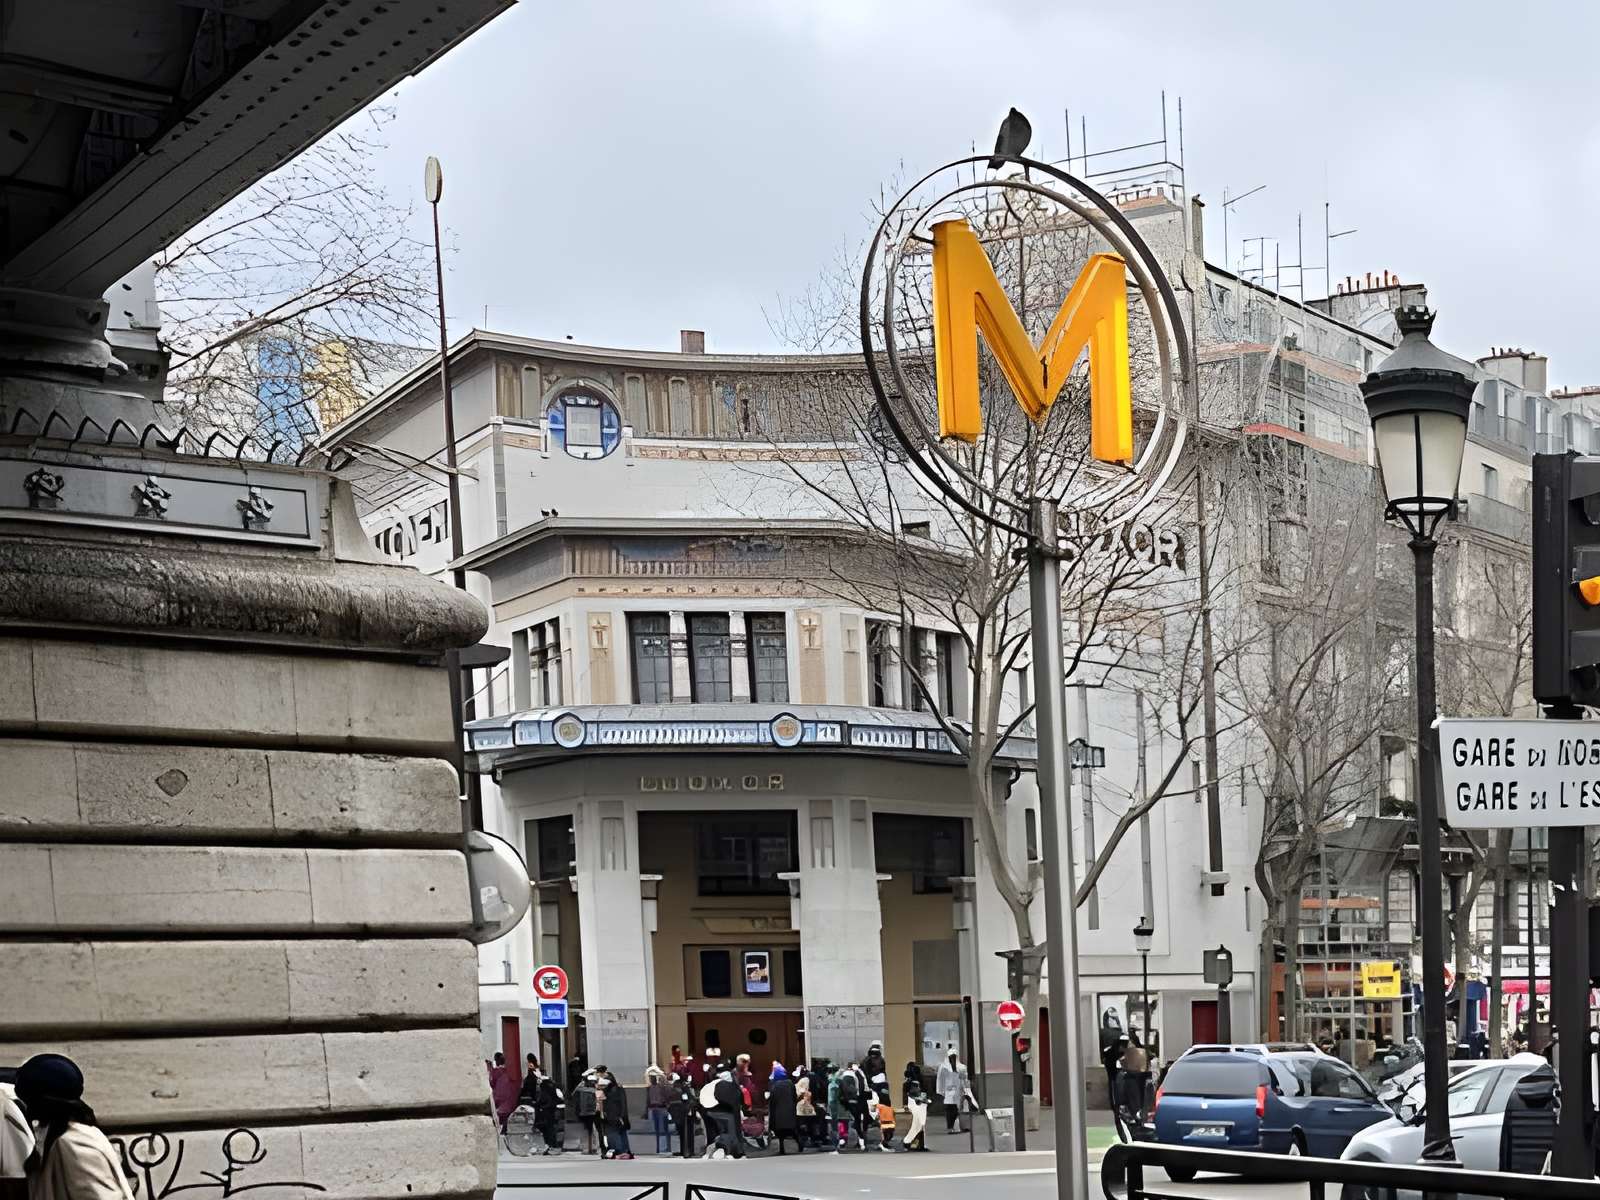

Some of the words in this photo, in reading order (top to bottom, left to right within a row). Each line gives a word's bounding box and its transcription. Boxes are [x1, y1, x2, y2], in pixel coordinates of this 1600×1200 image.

[931, 218, 1134, 467] M
[1453, 737, 1516, 768] GARE
[1456, 781, 1519, 812] GARE
